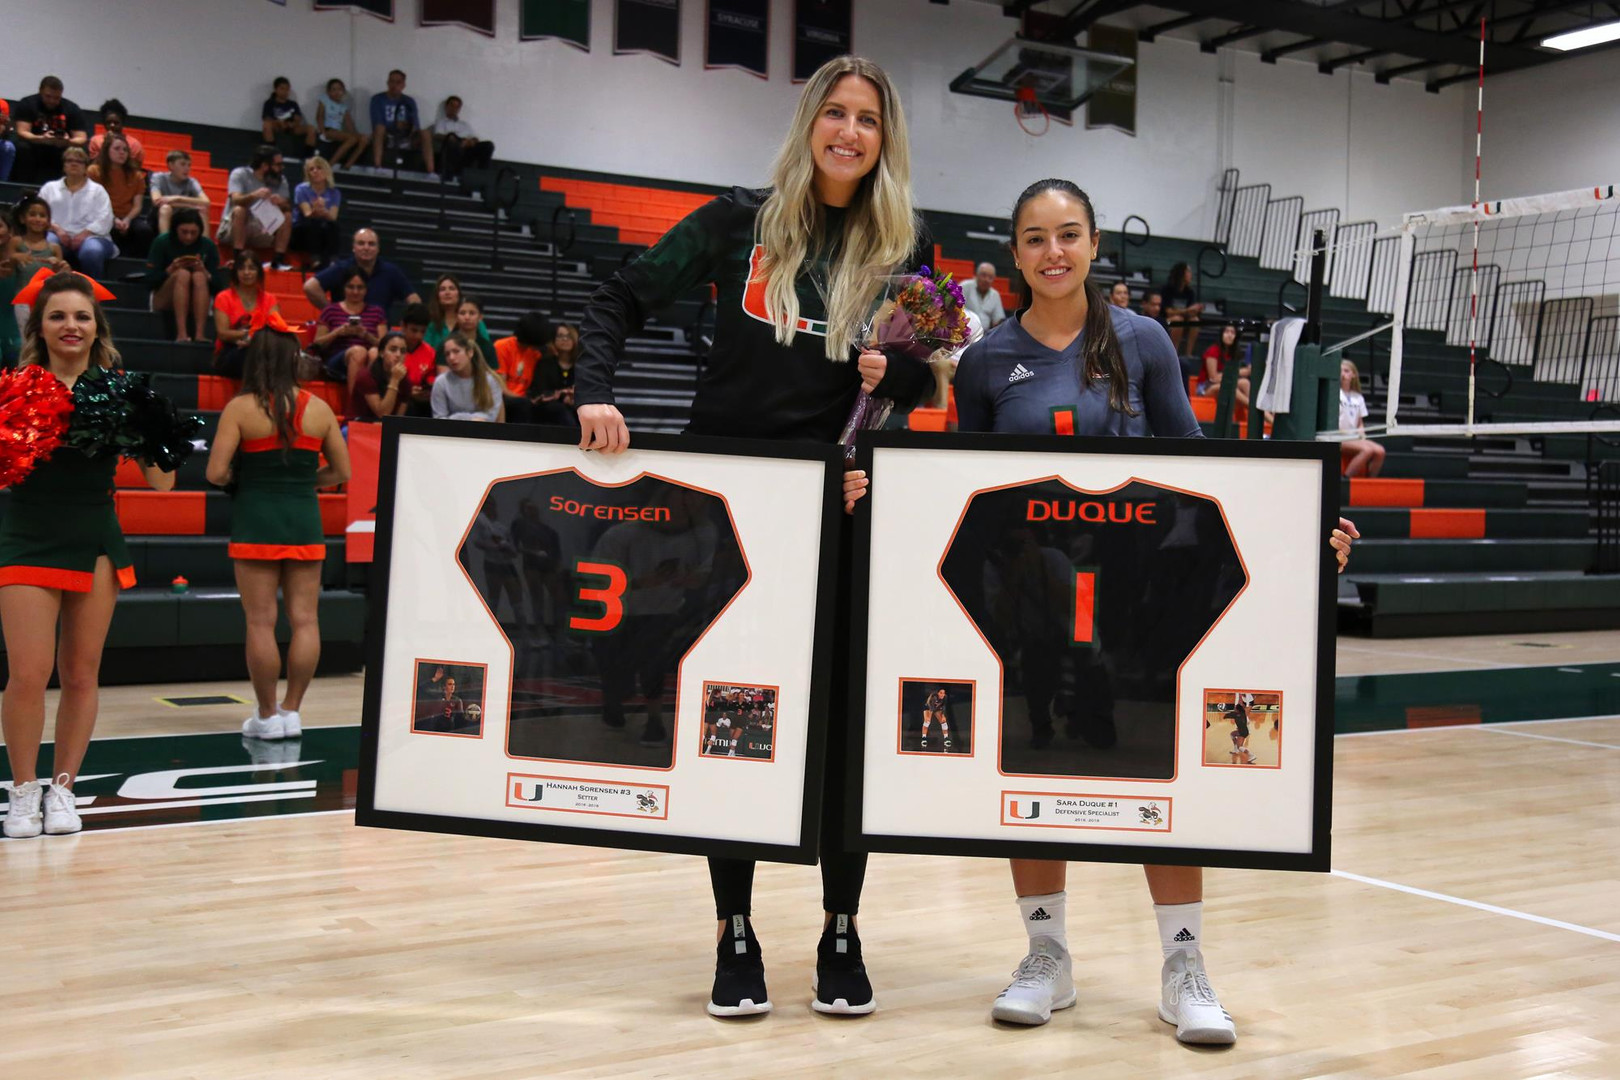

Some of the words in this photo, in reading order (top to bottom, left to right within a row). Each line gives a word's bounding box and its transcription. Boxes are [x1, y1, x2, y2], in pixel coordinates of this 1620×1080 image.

[717, 13, 760, 28] SYRACUSE
[1594, 185, 1613, 200] U
[1484, 202, 1501, 215] U
[1008, 370, 1035, 382] adidas
[1026, 499, 1157, 524] DUQUE
[569, 561, 628, 632] 3
[1072, 570, 1096, 644] 1
[514, 782, 543, 801] U
[1009, 800, 1040, 820] U
